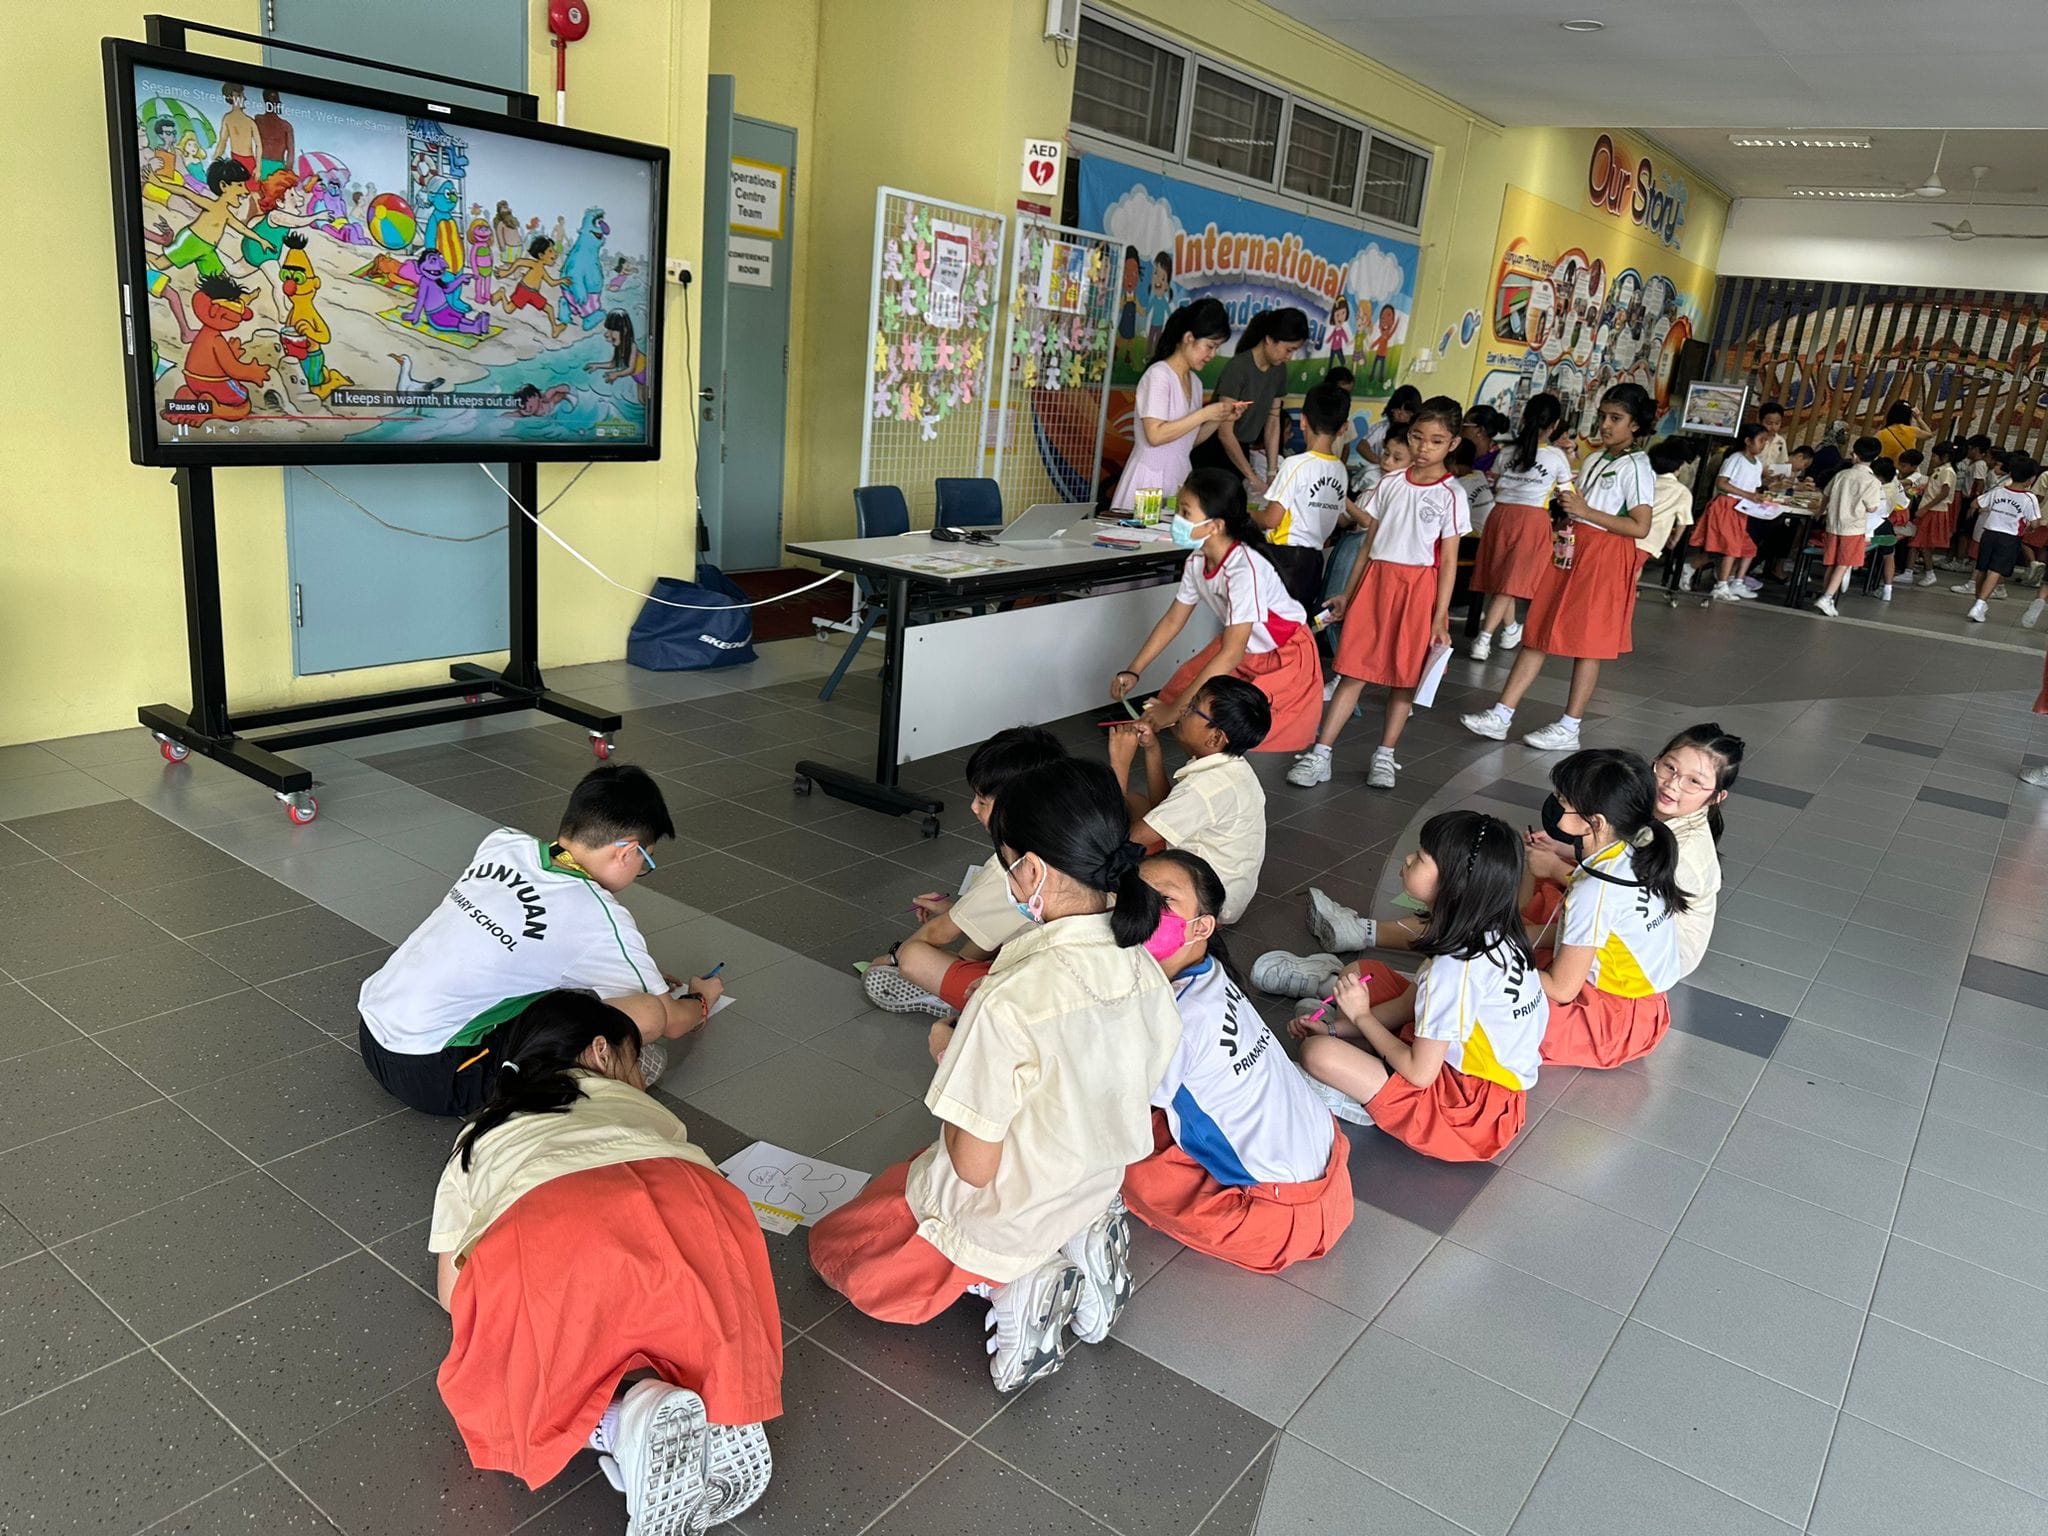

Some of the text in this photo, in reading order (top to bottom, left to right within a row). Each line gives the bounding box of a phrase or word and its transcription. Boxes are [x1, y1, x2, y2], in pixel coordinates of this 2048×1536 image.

[142, 80, 190, 97] Sesame
[346, 116, 363, 127] the
[1029, 144, 1058, 158] AED
[735, 187, 766, 204] Centre
[1589, 132, 1680, 247] Our Story
[737, 204, 763, 220] Team
[728, 251, 770, 264] CONFERENCE
[1173, 223, 1349, 299] International
[738, 264, 760, 276] ROOM
[169, 402, 209, 413] Pause (k)
[334, 391, 343, 404] It
[345, 392, 380, 407] keeps
[384, 393, 393, 405] in
[396, 393, 441, 407] warmth,
[443, 394, 451, 406] it
[452, 394, 484, 409] keeps
[486, 396, 503, 407] out
[1309, 476, 1344, 501] JUNYUAN
[461, 862, 547, 941] JUNYUAN
[469, 908, 518, 952] SCHOOL
[1646, 912, 1667, 932] PRIM
